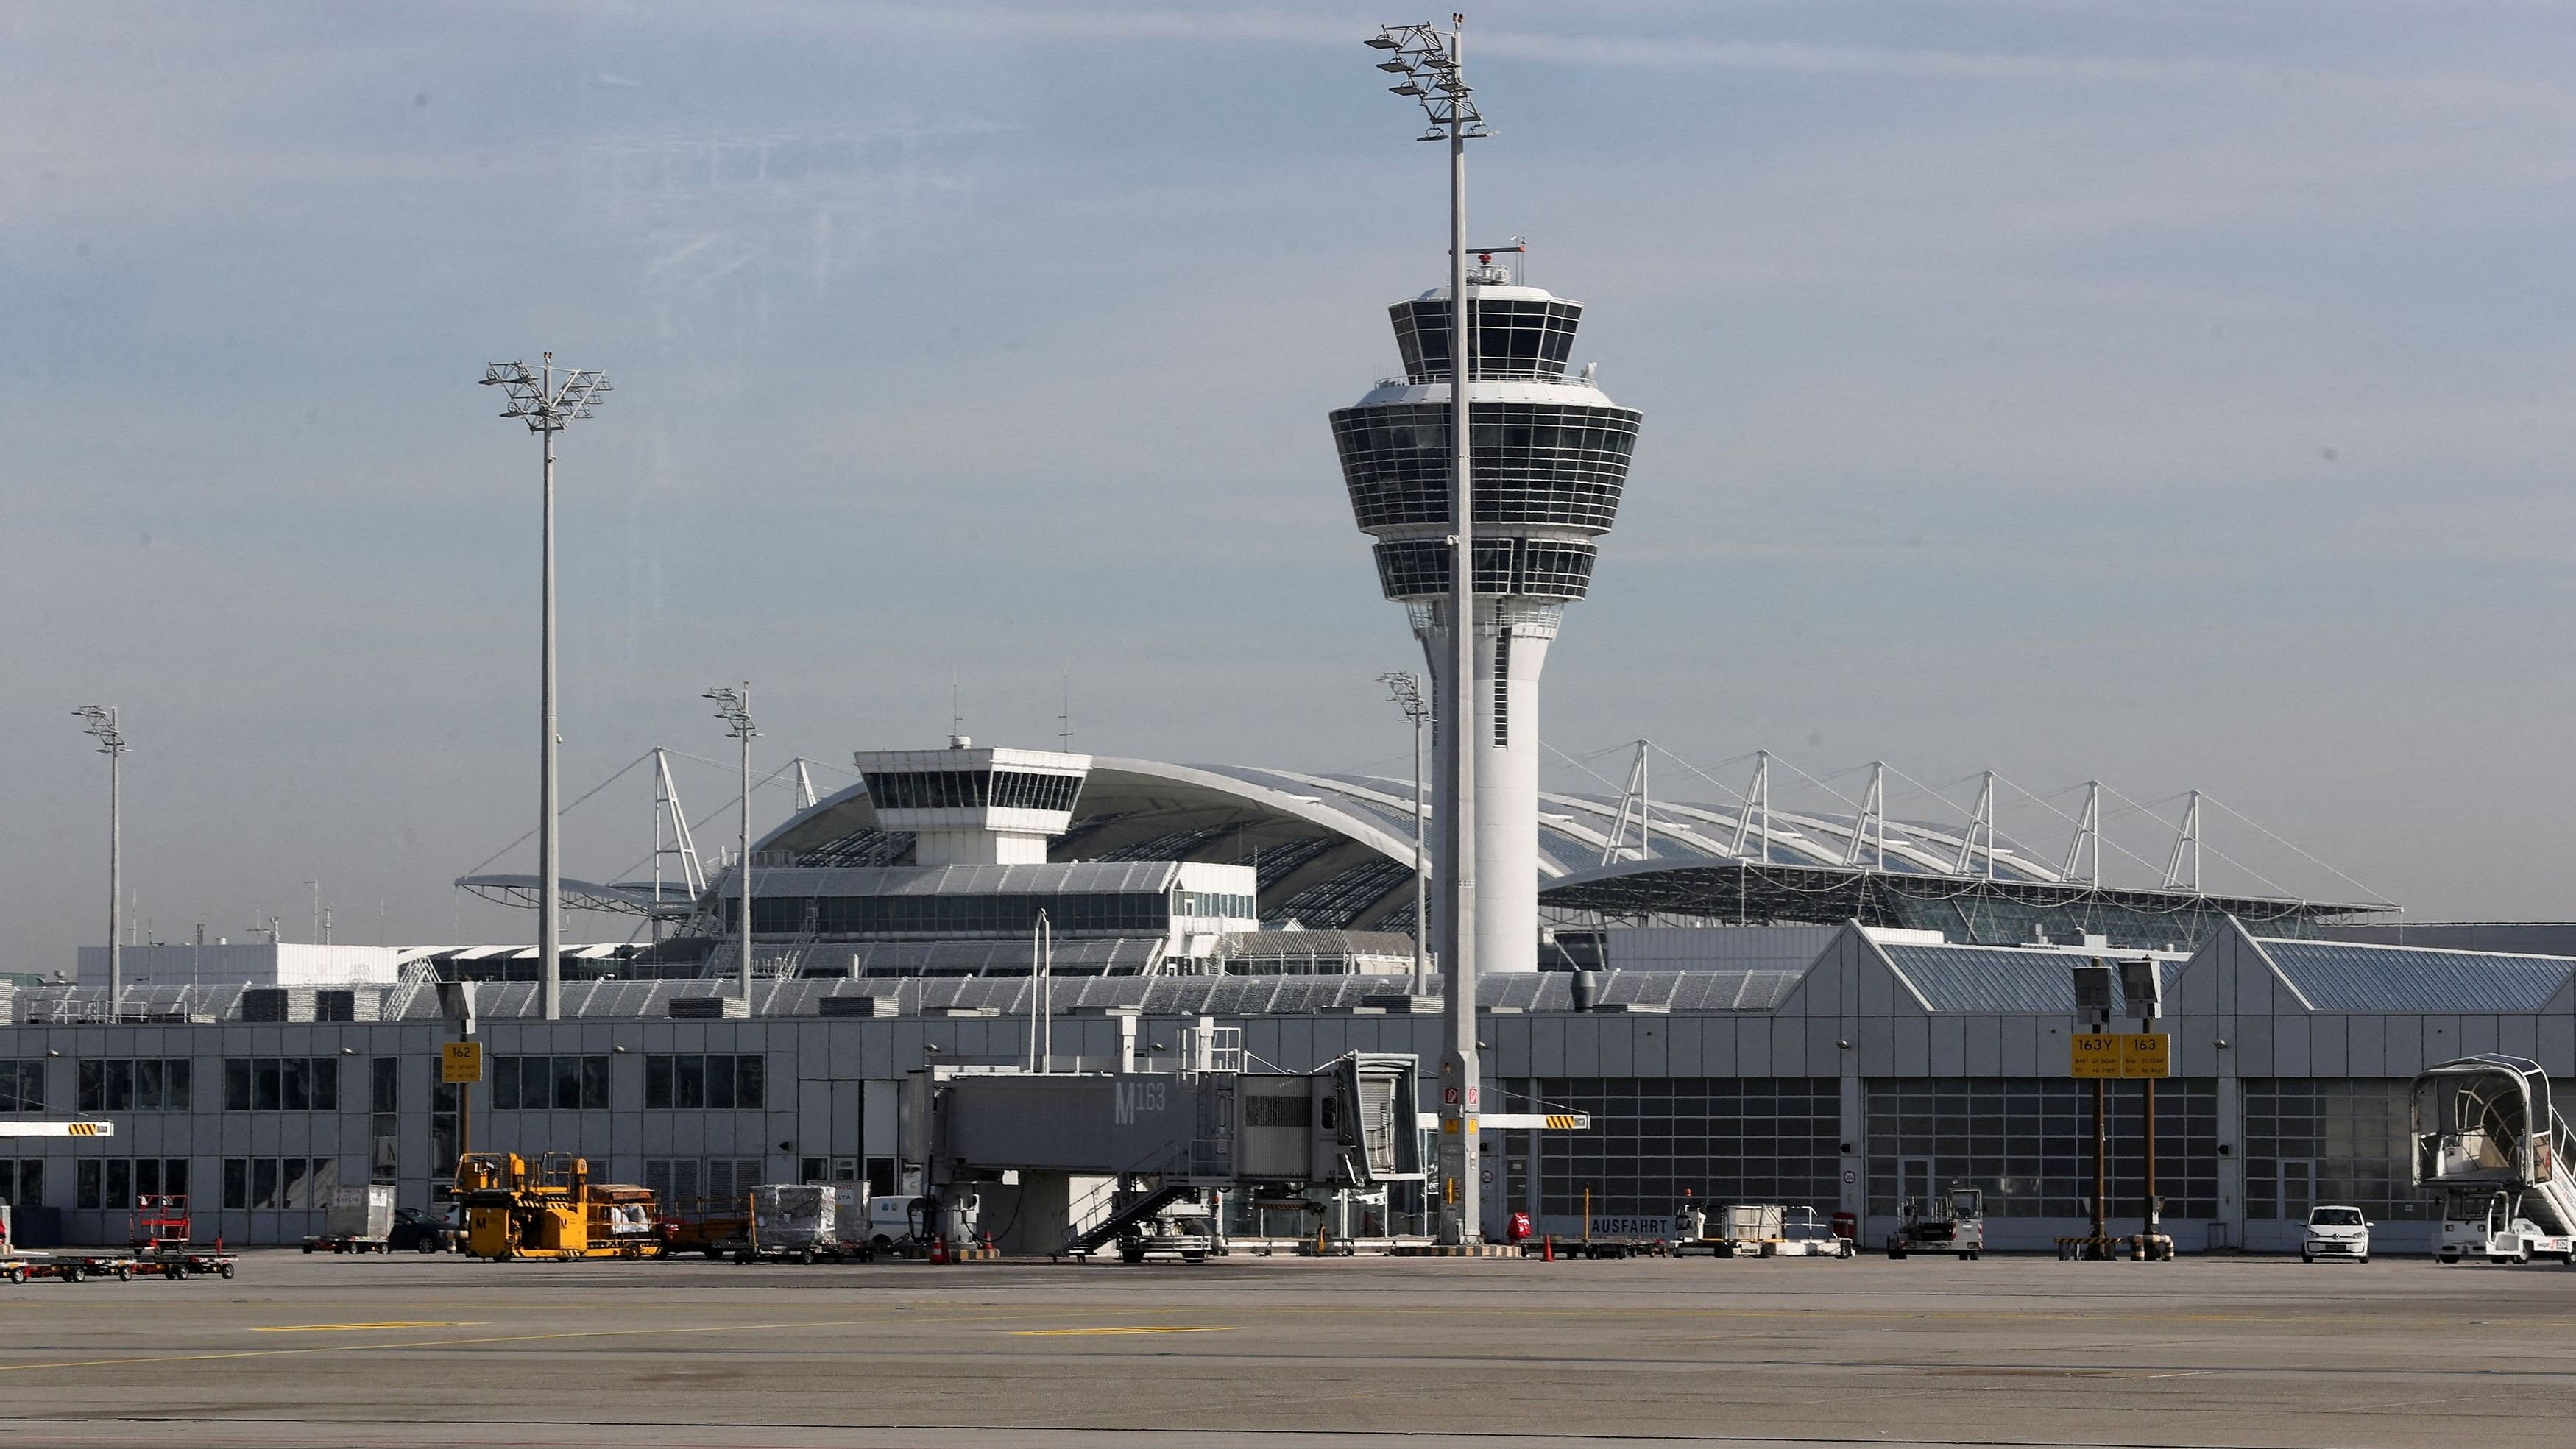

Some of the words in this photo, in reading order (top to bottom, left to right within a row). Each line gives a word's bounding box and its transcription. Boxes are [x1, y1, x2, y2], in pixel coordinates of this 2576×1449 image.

[2078, 1038, 2112, 1051] 163Y
[2134, 1039, 2156, 1051] 163
[453, 1047, 471, 1058] 162
[476, 1217, 486, 1229] M
[1592, 1219, 1667, 1233] AUSFAHRT
